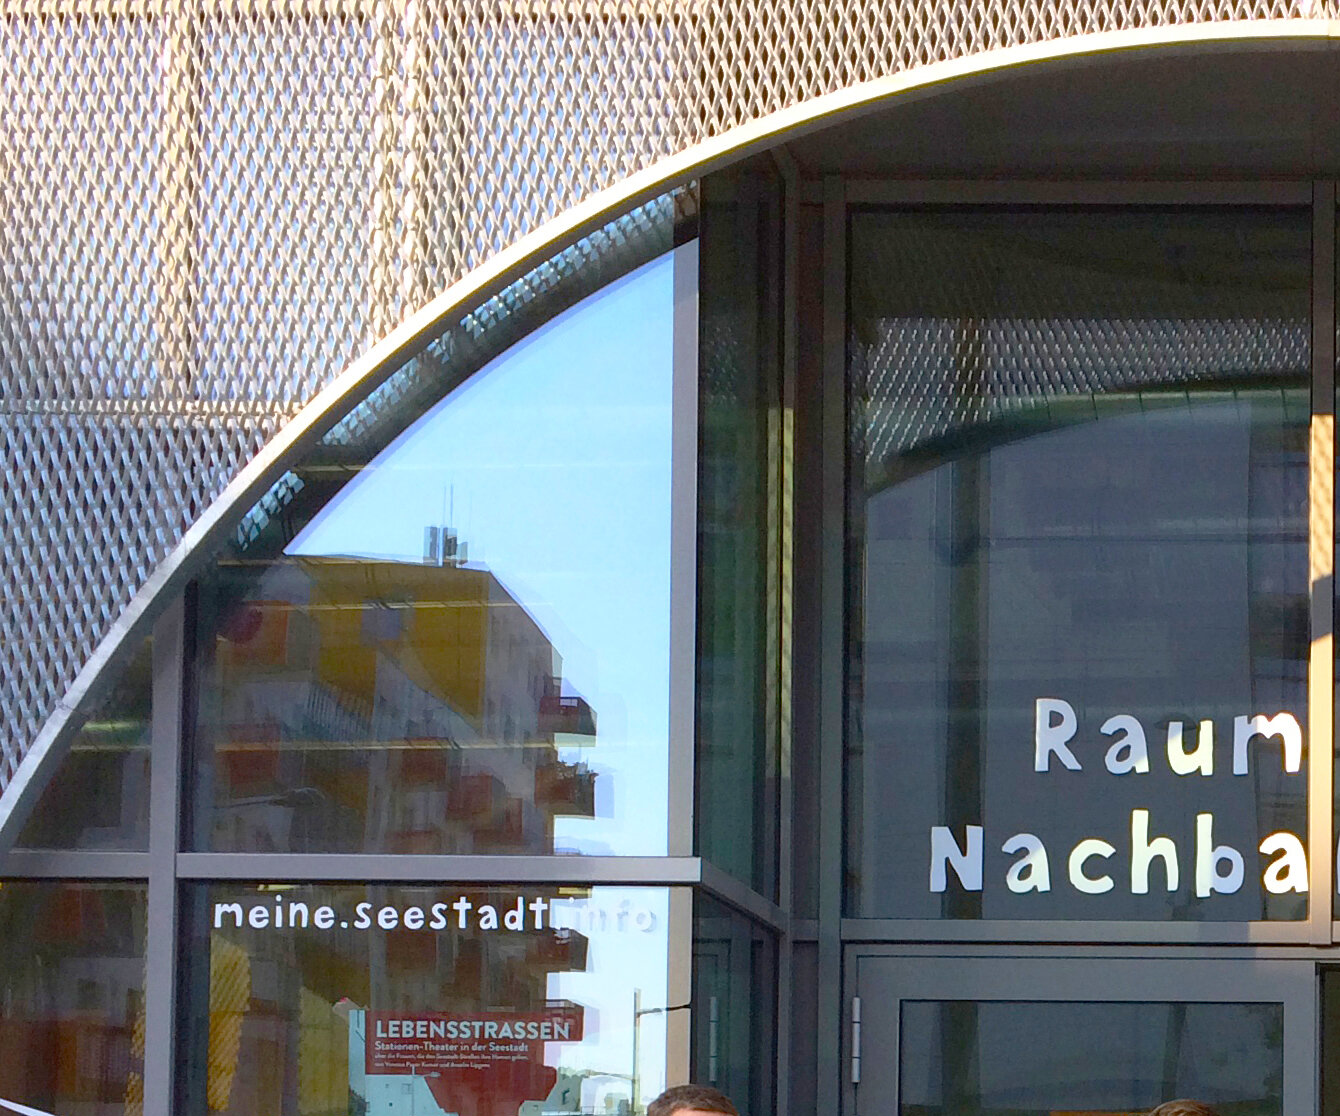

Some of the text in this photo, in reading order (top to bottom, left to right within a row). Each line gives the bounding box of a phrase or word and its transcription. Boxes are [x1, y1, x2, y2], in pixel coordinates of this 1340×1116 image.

[1034, 698, 1302, 776] Raum
[375, 1019, 570, 1040] LEBENSSTRASSEN
[374, 1041, 459, 1051] Stationen-Theater
[471, 1042, 487, 1051] der
[489, 1042, 529, 1052] Seestadt
